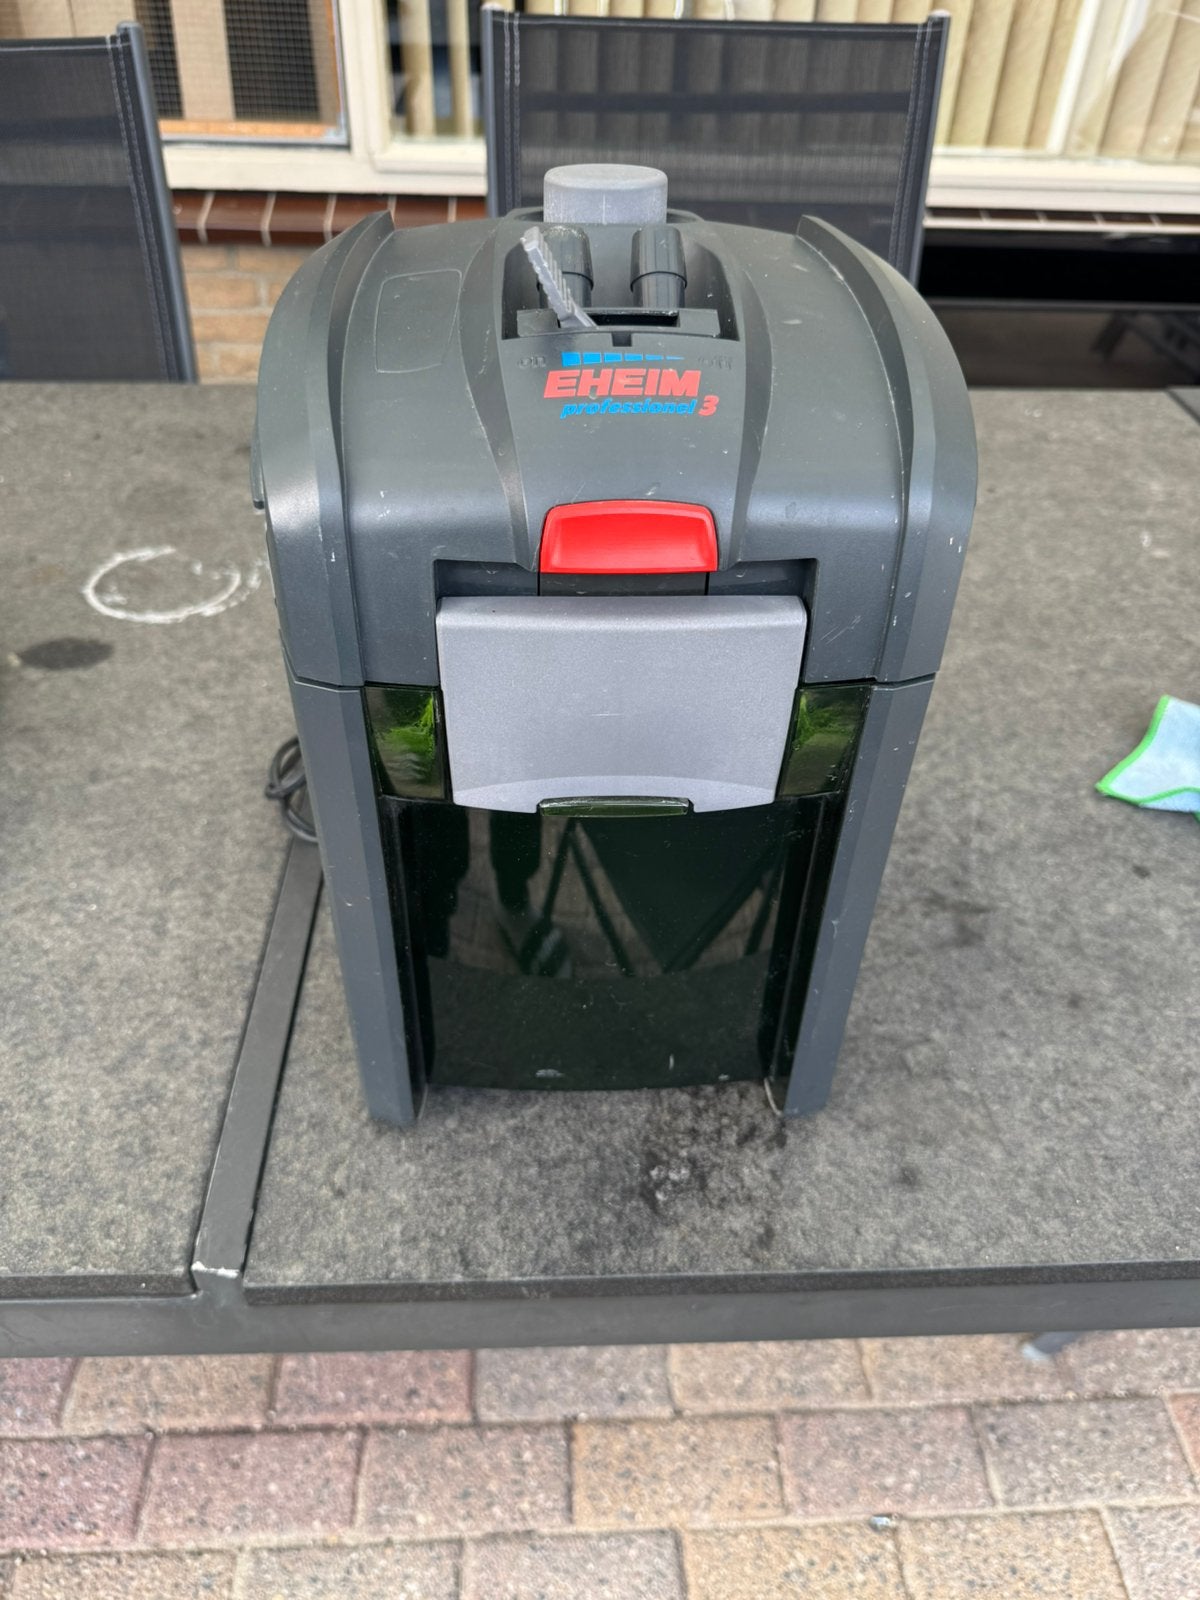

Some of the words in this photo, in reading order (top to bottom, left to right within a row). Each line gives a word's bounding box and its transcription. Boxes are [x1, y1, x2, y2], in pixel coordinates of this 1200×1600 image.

[543, 368, 701, 399] EHEIM
[560, 398, 698, 420] professional
[698, 395, 720, 417] 3
